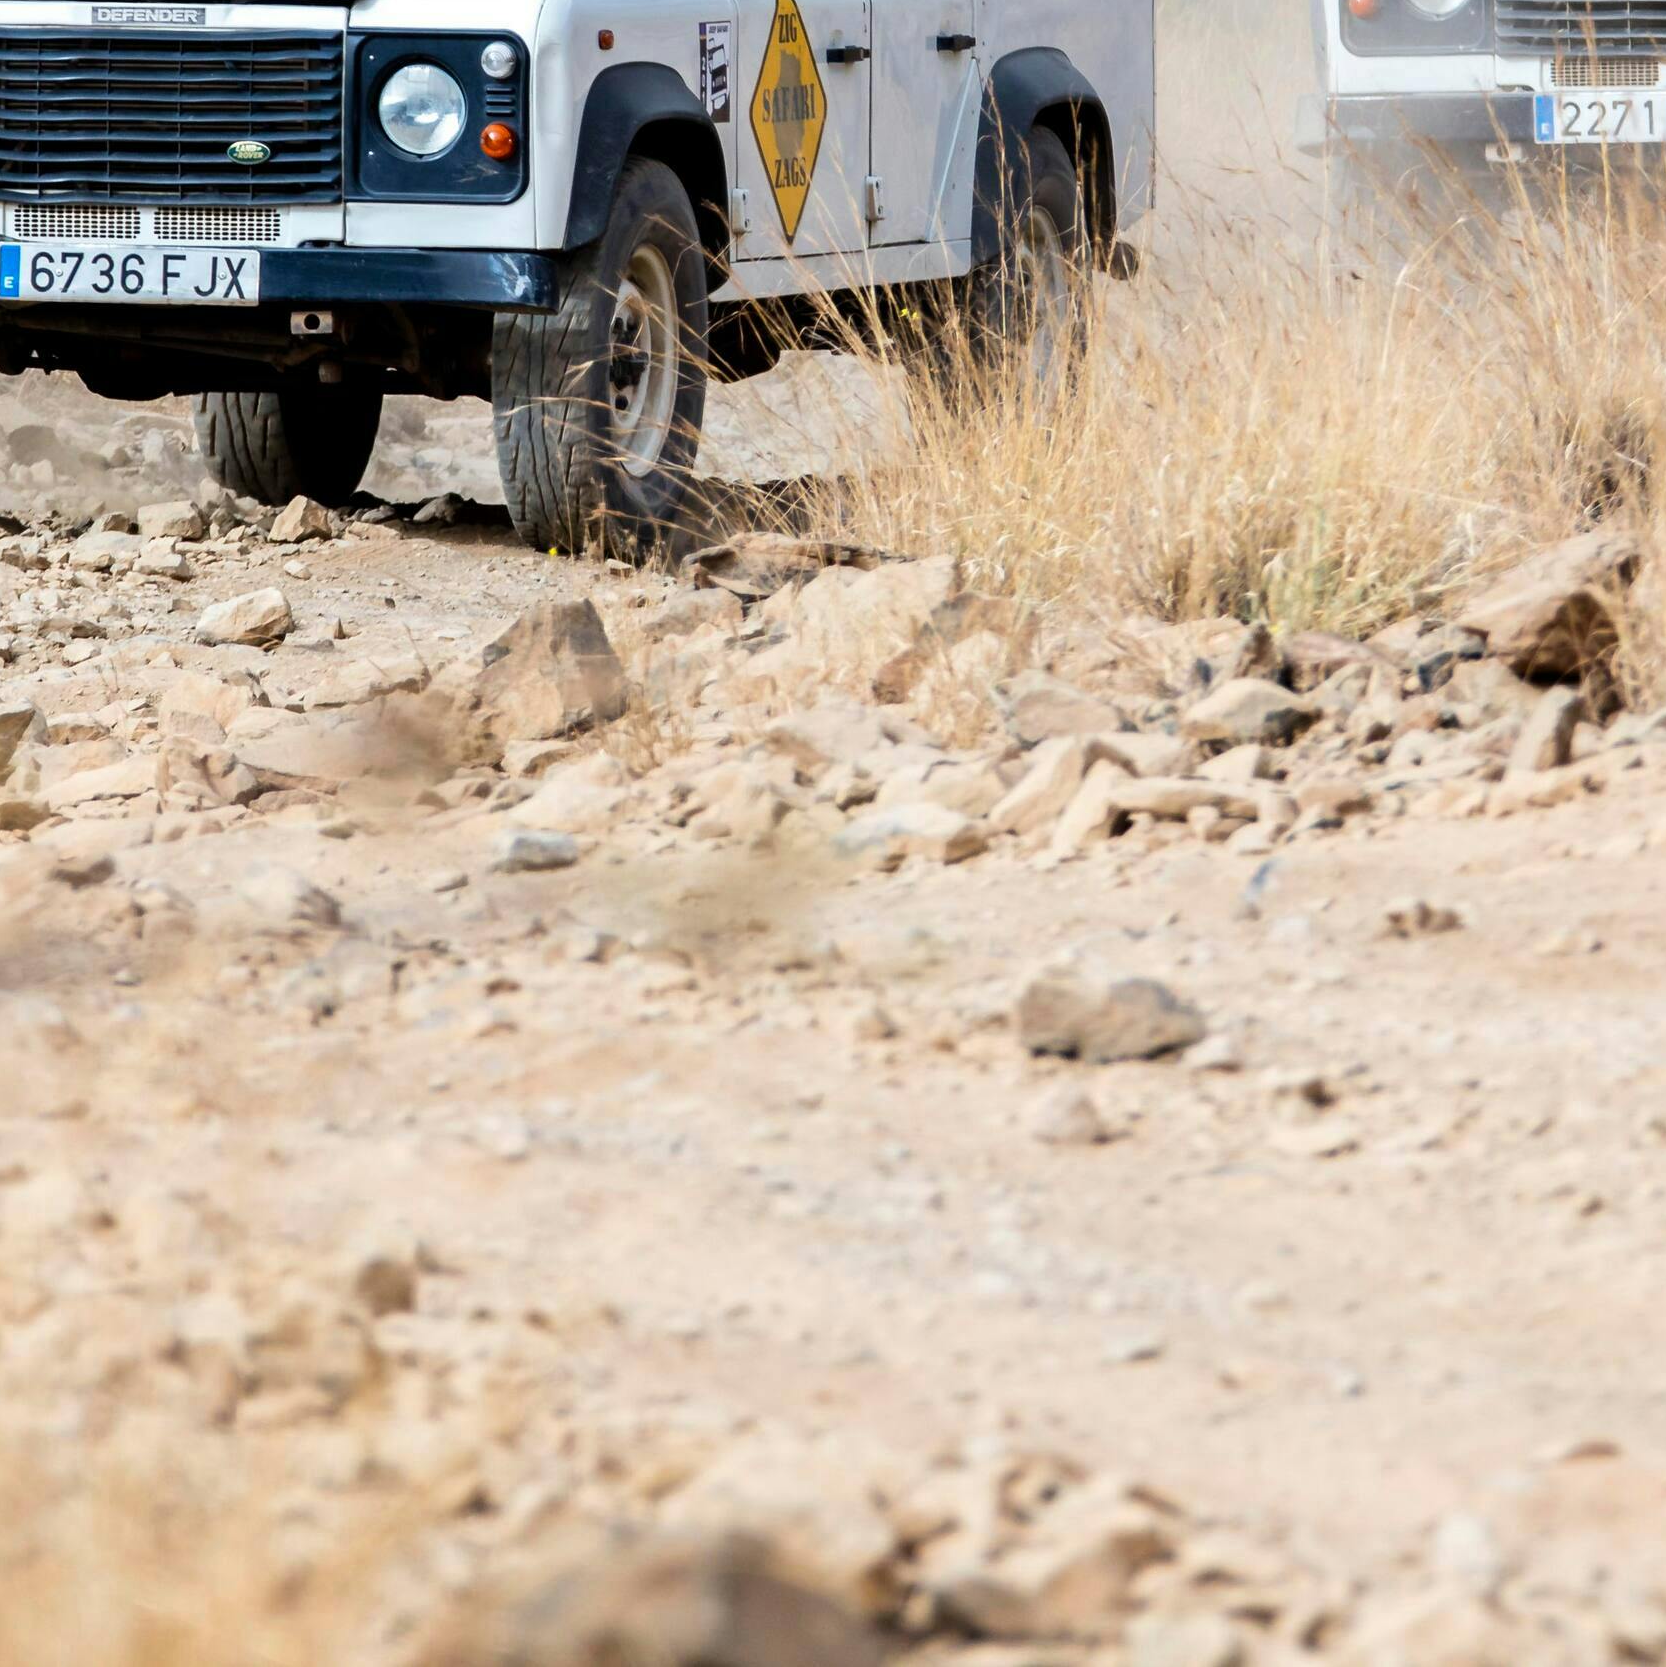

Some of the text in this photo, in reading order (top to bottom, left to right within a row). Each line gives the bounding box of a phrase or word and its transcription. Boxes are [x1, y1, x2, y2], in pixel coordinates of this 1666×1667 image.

[97, 8, 198, 23] DEFENDER
[777, 13, 798, 44] ZIG
[762, 83, 816, 123] SAFARI
[1561, 99, 1655, 137] 2271
[774, 157, 806, 189] ZAGS
[3, 276, 14, 289] E
[30, 251, 145, 295] 6736
